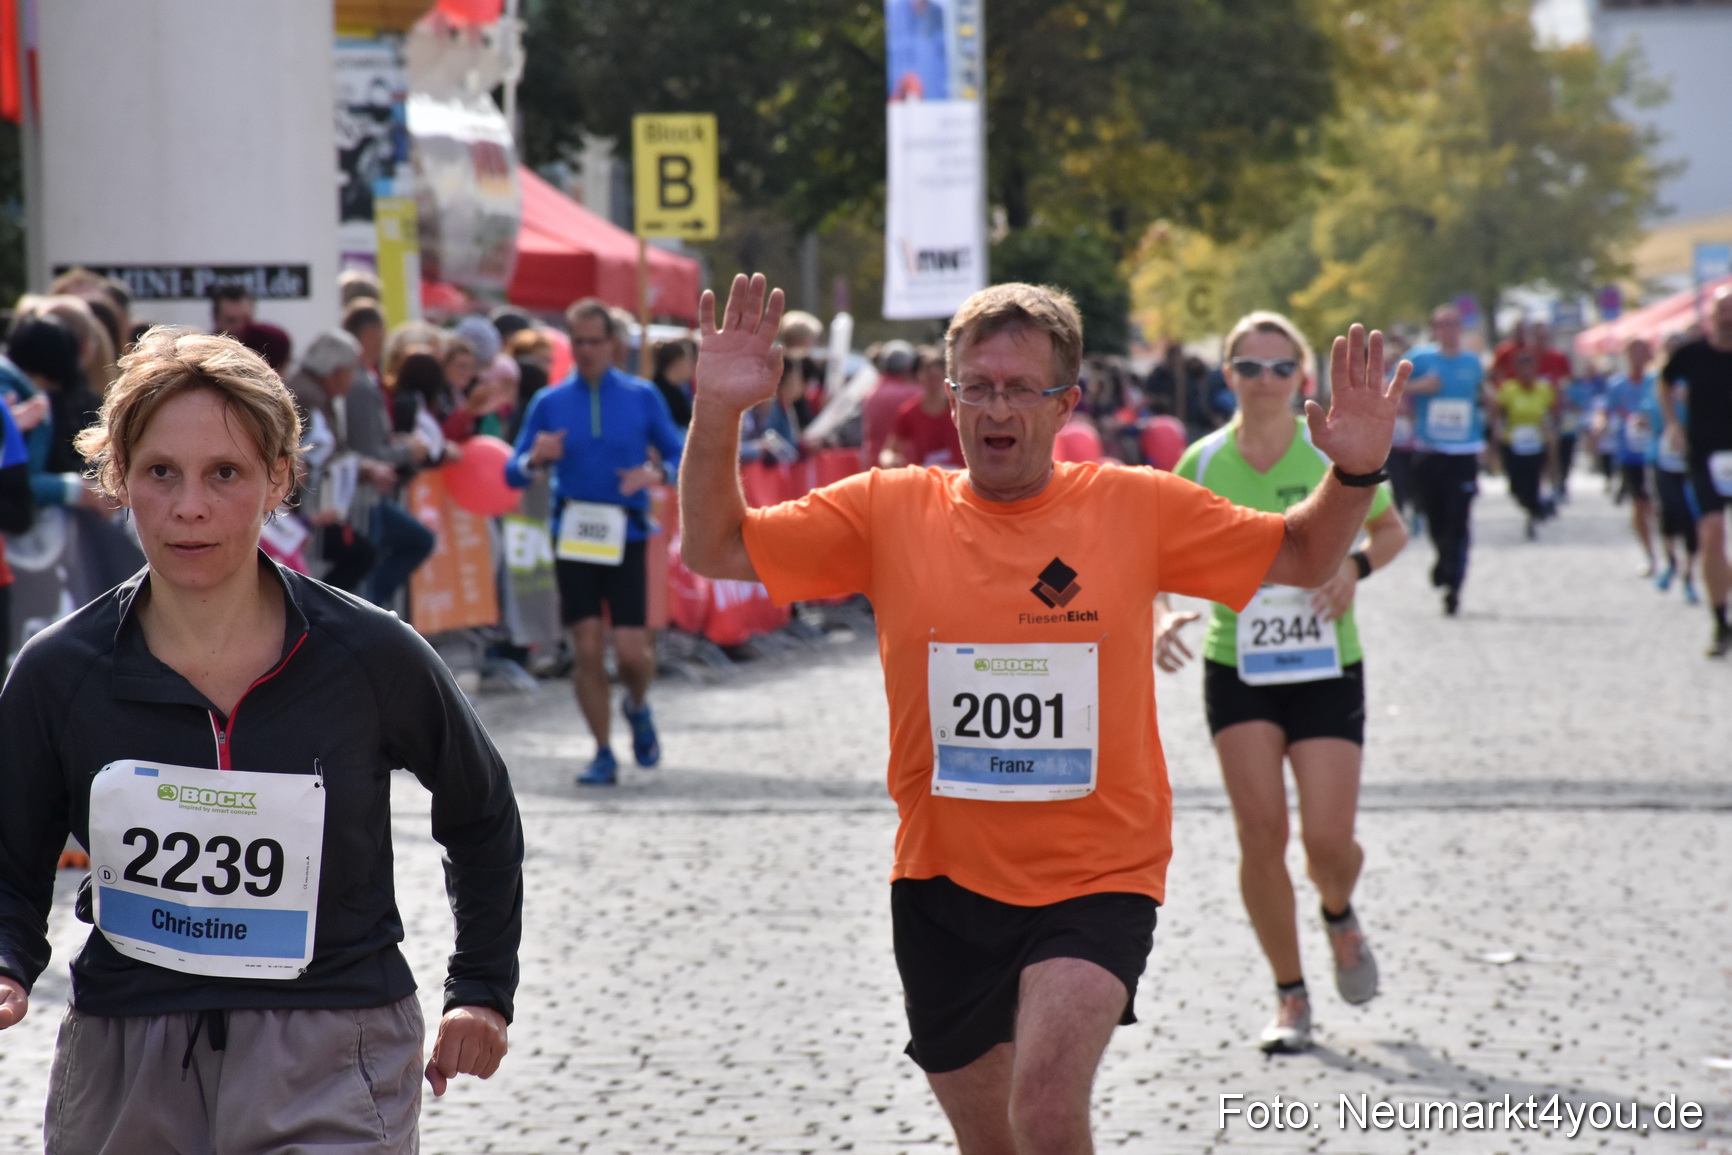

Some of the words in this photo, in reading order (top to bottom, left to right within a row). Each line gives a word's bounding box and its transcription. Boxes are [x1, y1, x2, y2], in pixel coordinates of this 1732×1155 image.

[658, 154, 695, 210] B
[1018, 610, 1099, 625] FliesenEichl
[1251, 614, 1321, 646] 2344
[991, 658, 1048, 672] BOCK
[953, 692, 1064, 739] 2091
[990, 756, 1035, 773] Franz
[178, 803, 202, 812] inspired
[179, 785, 257, 809] BOCK
[122, 826, 285, 898] 2239
[103, 869, 111, 880] D
[151, 908, 248, 940] Christine
